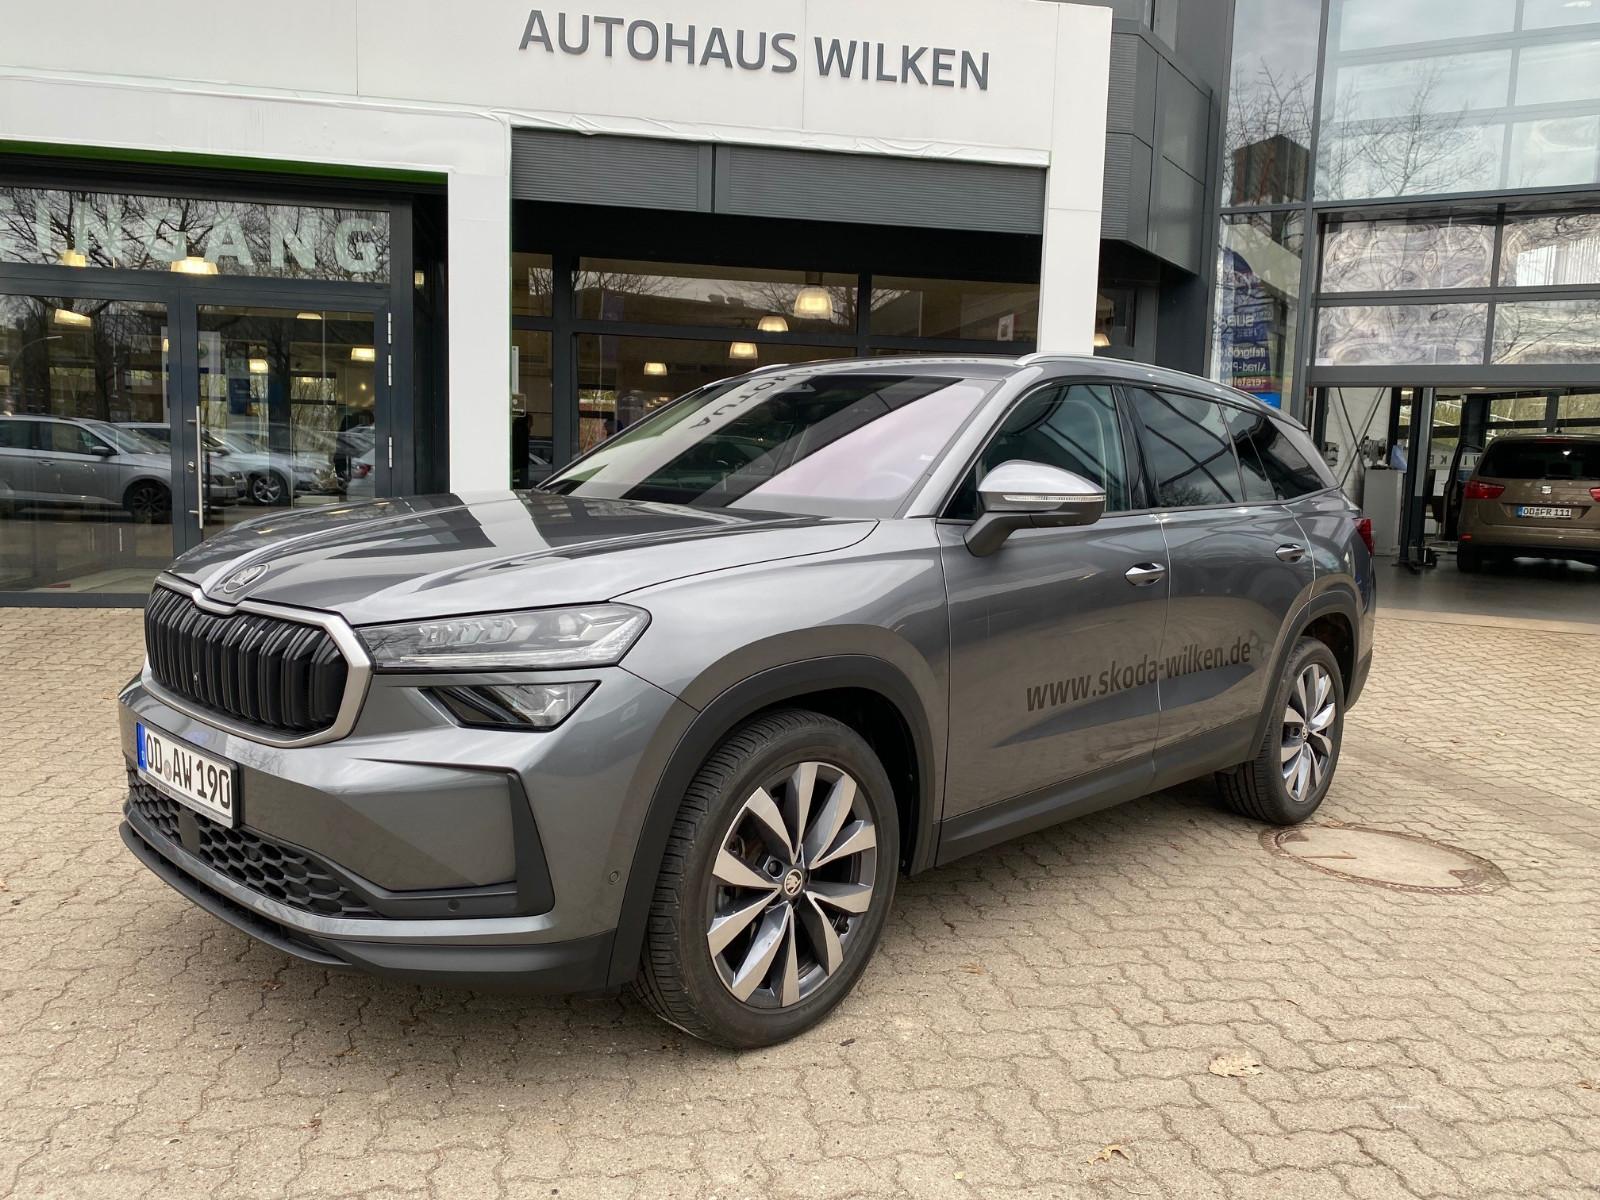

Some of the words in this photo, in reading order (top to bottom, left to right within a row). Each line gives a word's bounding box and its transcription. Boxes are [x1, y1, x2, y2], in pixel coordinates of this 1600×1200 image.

[518, 9, 798, 74] AUTOHAUS
[814, 36, 990, 91] WILKEN
[1026, 636, 1250, 712] www.skoda-wilken.de
[146, 733, 163, 774] OD
[173, 747, 192, 792] AW
[196, 759, 231, 810] 190
